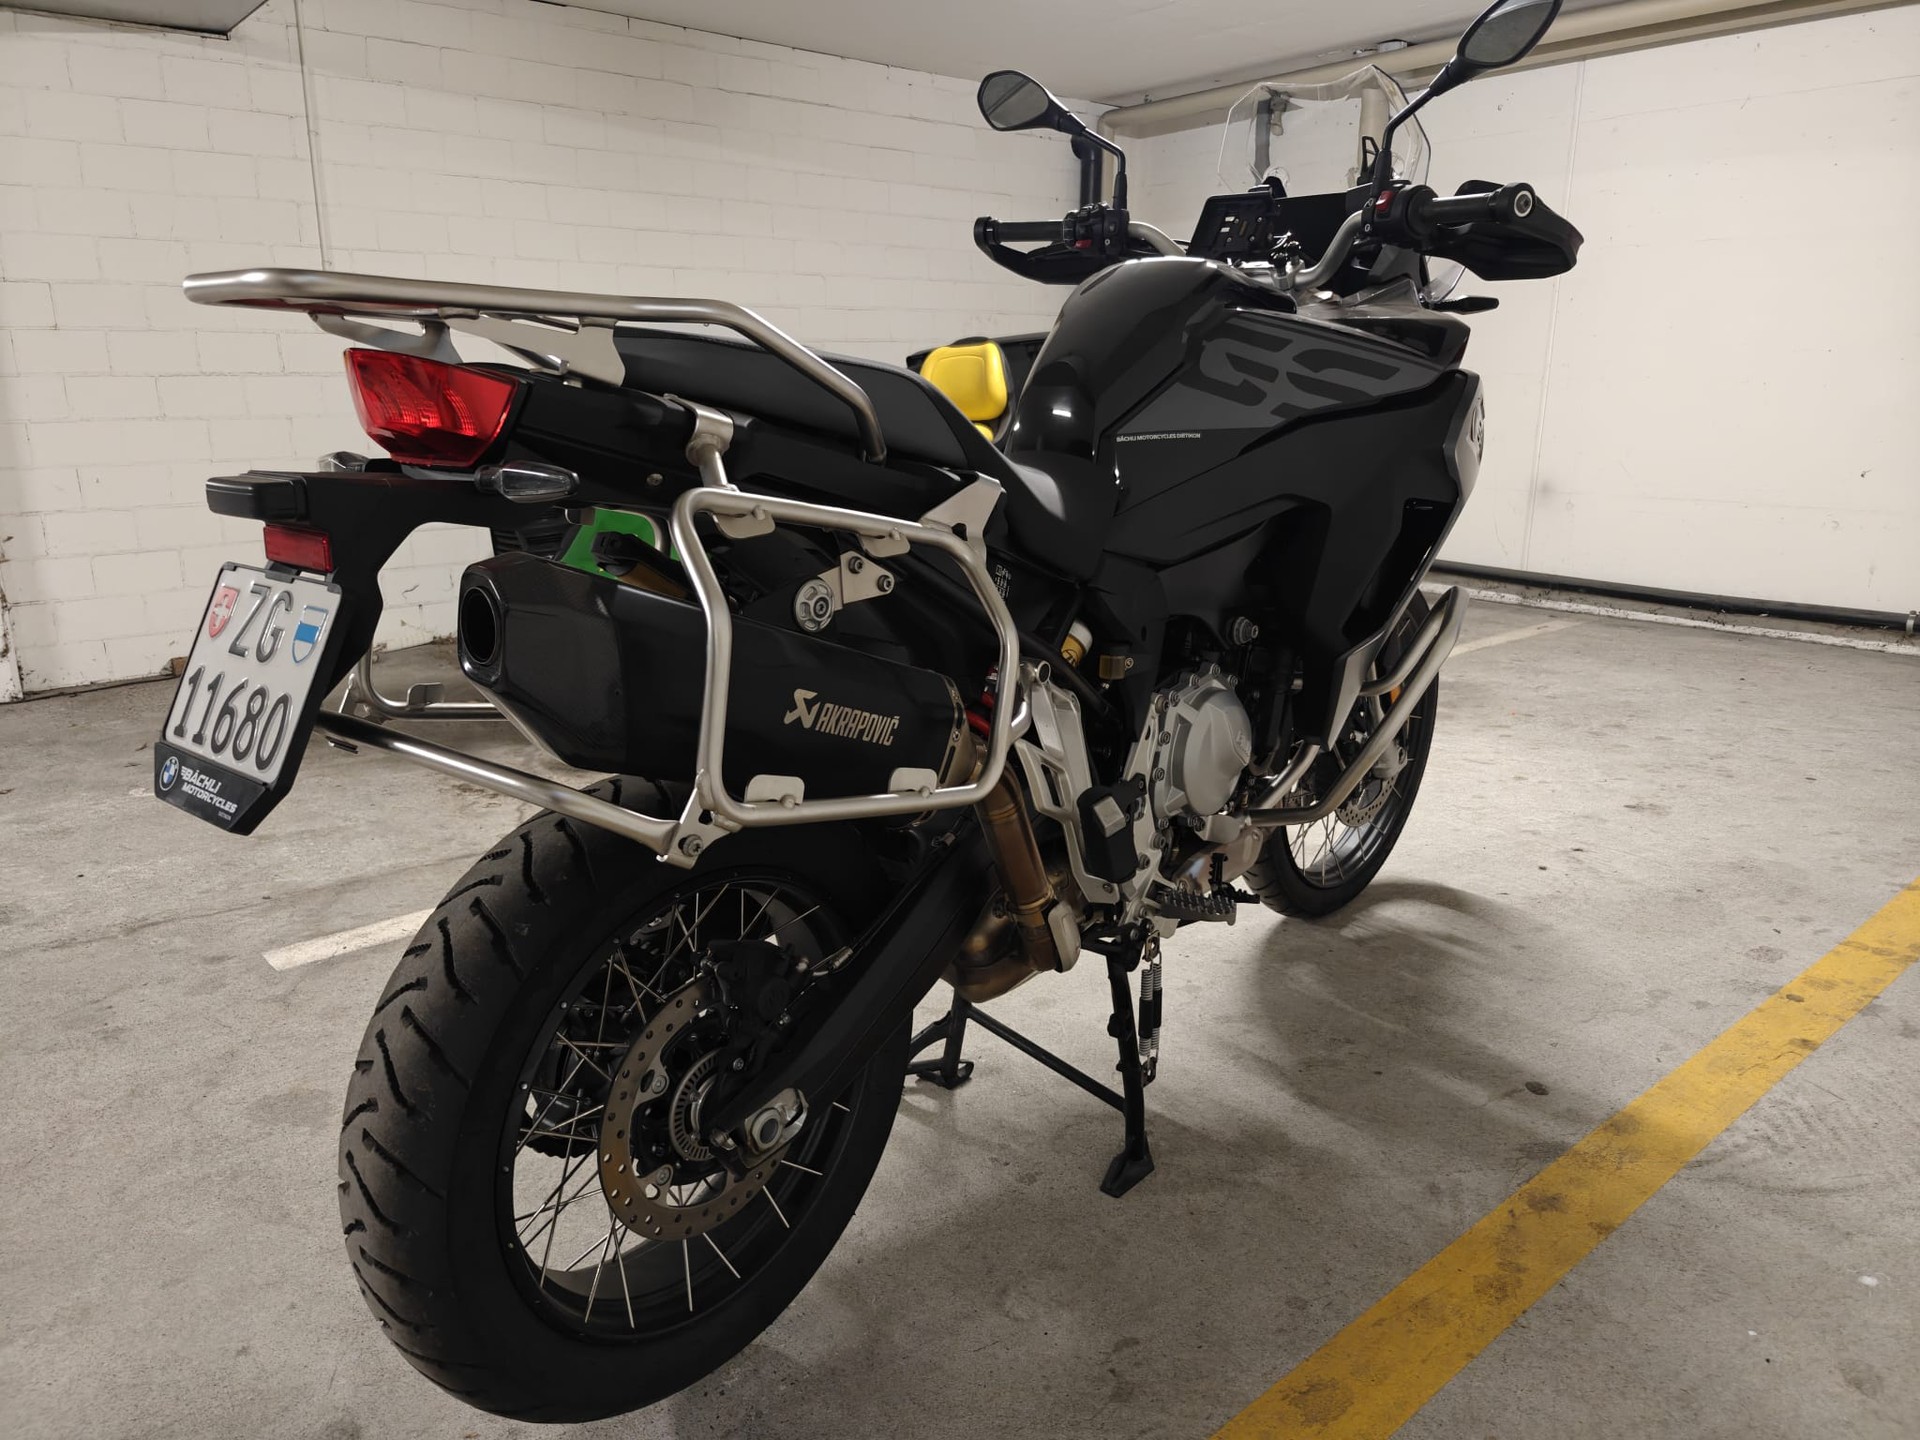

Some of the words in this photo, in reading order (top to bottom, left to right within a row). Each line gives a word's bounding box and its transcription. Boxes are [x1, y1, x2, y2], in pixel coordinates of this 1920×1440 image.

[228, 583, 293, 663] ZG
[173, 665, 292, 769] 11680
[181, 782, 238, 814] MOTORCYCLES
